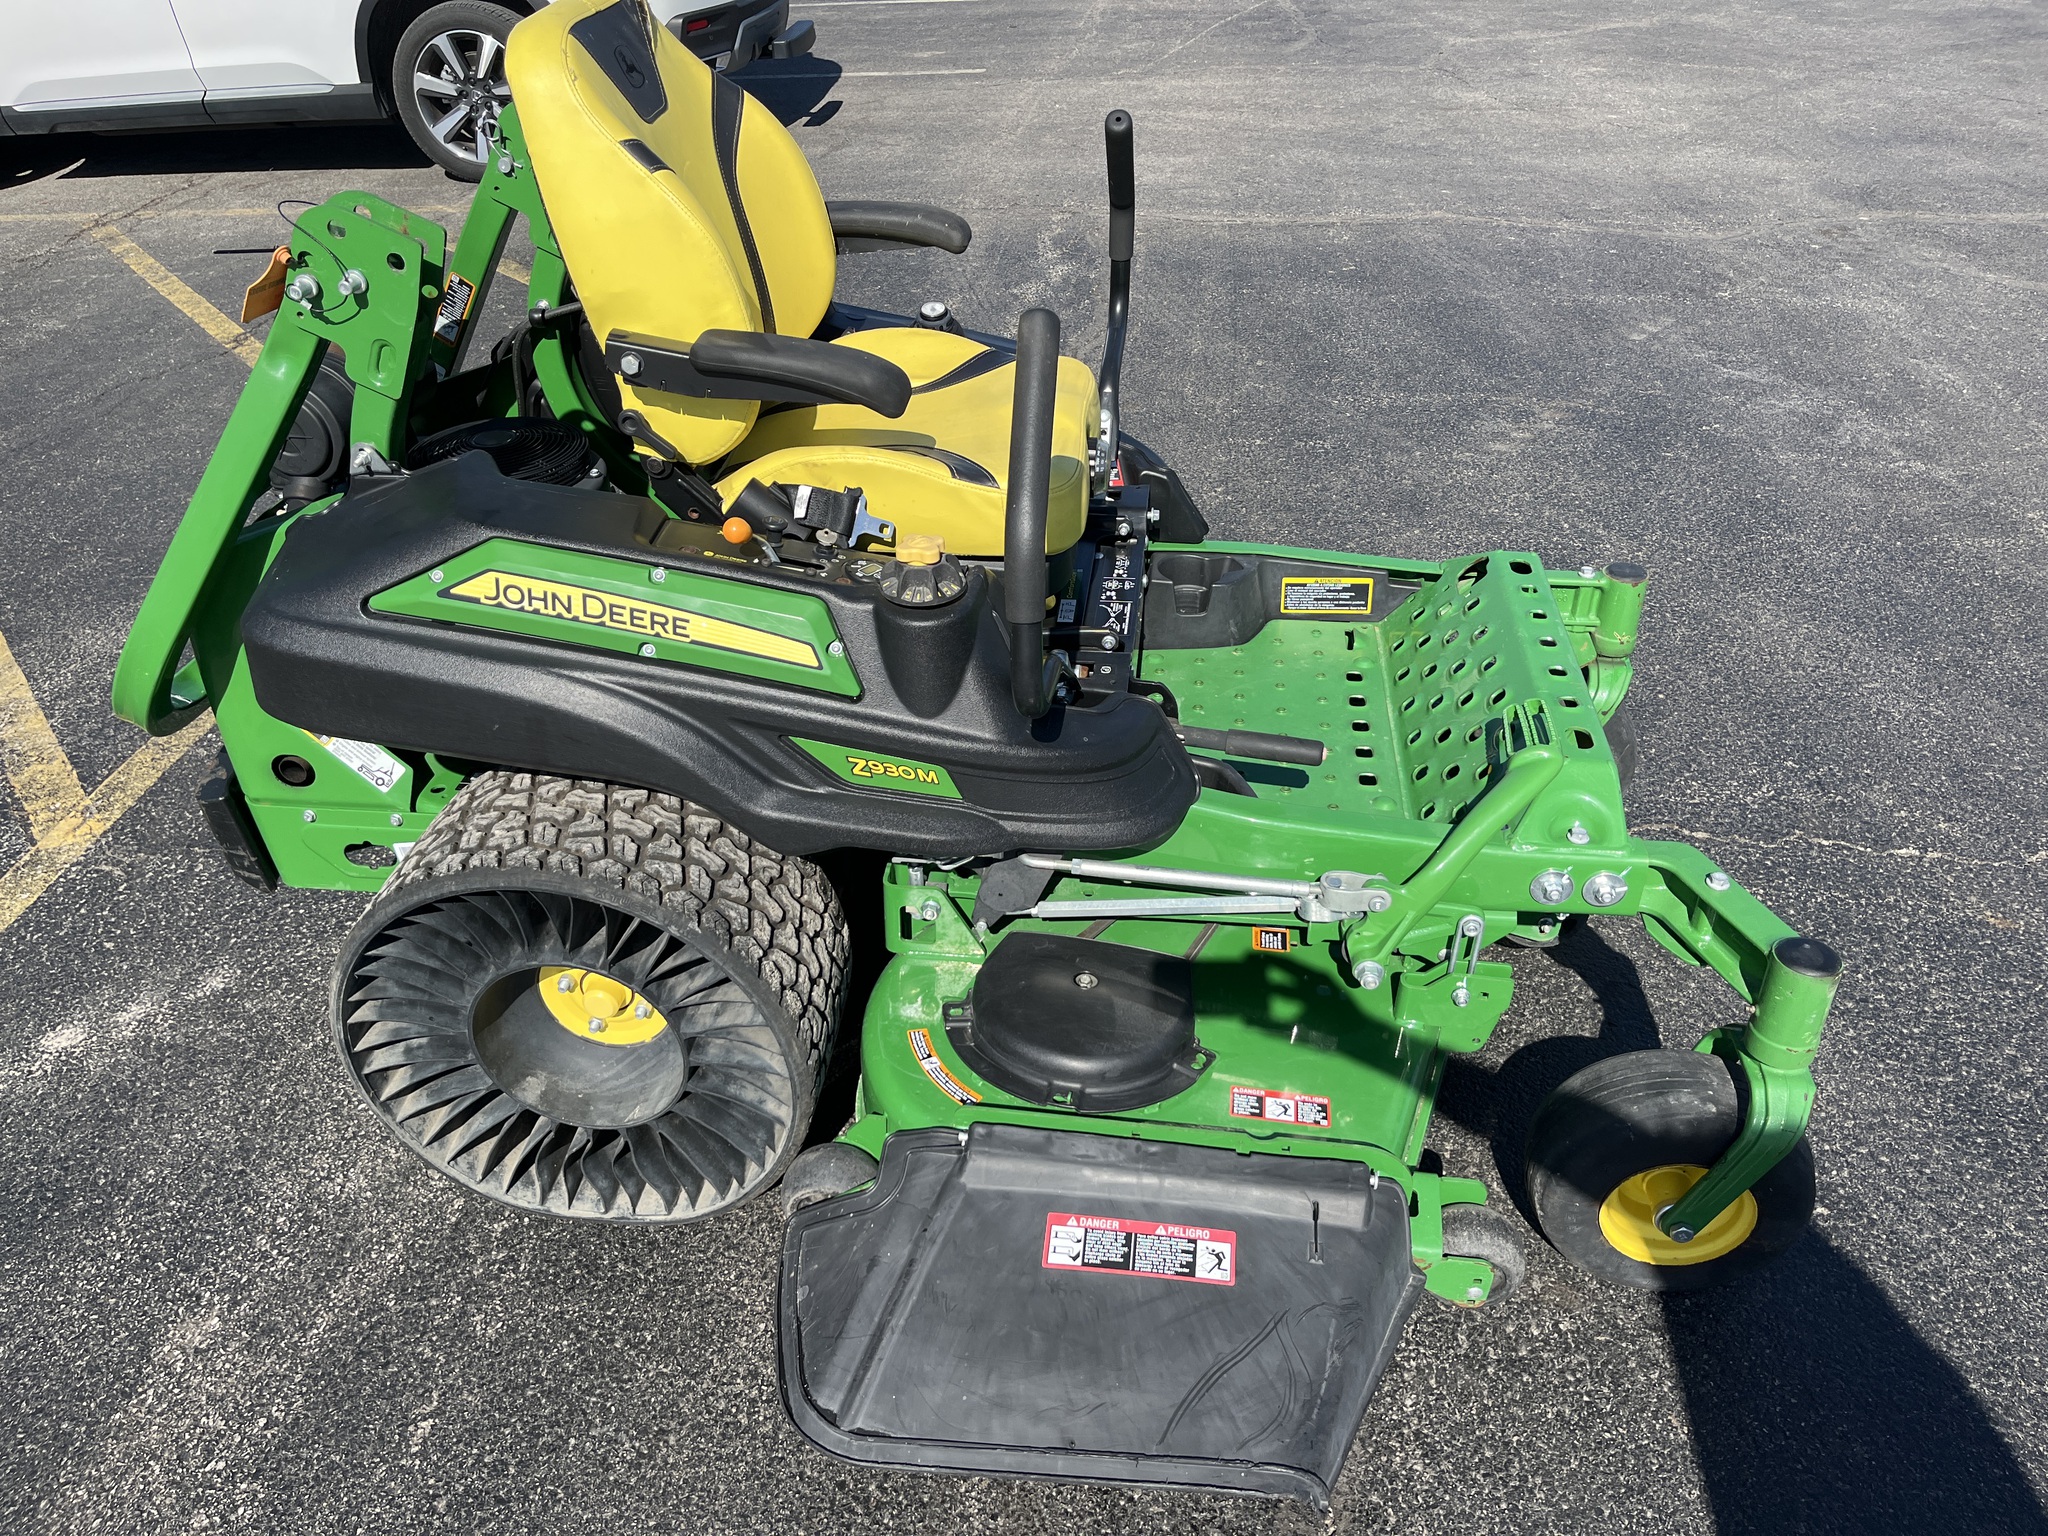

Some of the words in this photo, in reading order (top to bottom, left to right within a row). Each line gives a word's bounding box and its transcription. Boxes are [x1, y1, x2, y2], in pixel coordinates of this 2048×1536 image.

[484, 577, 573, 615] JOHN
[582, 593, 690, 638] DEERE
[1239, 1087, 1265, 1096] DANGER
[1301, 1095, 1328, 1104] PELIGRO
[1079, 1217, 1120, 1230] DANGER
[1167, 1226, 1210, 1239] PELIGRO
